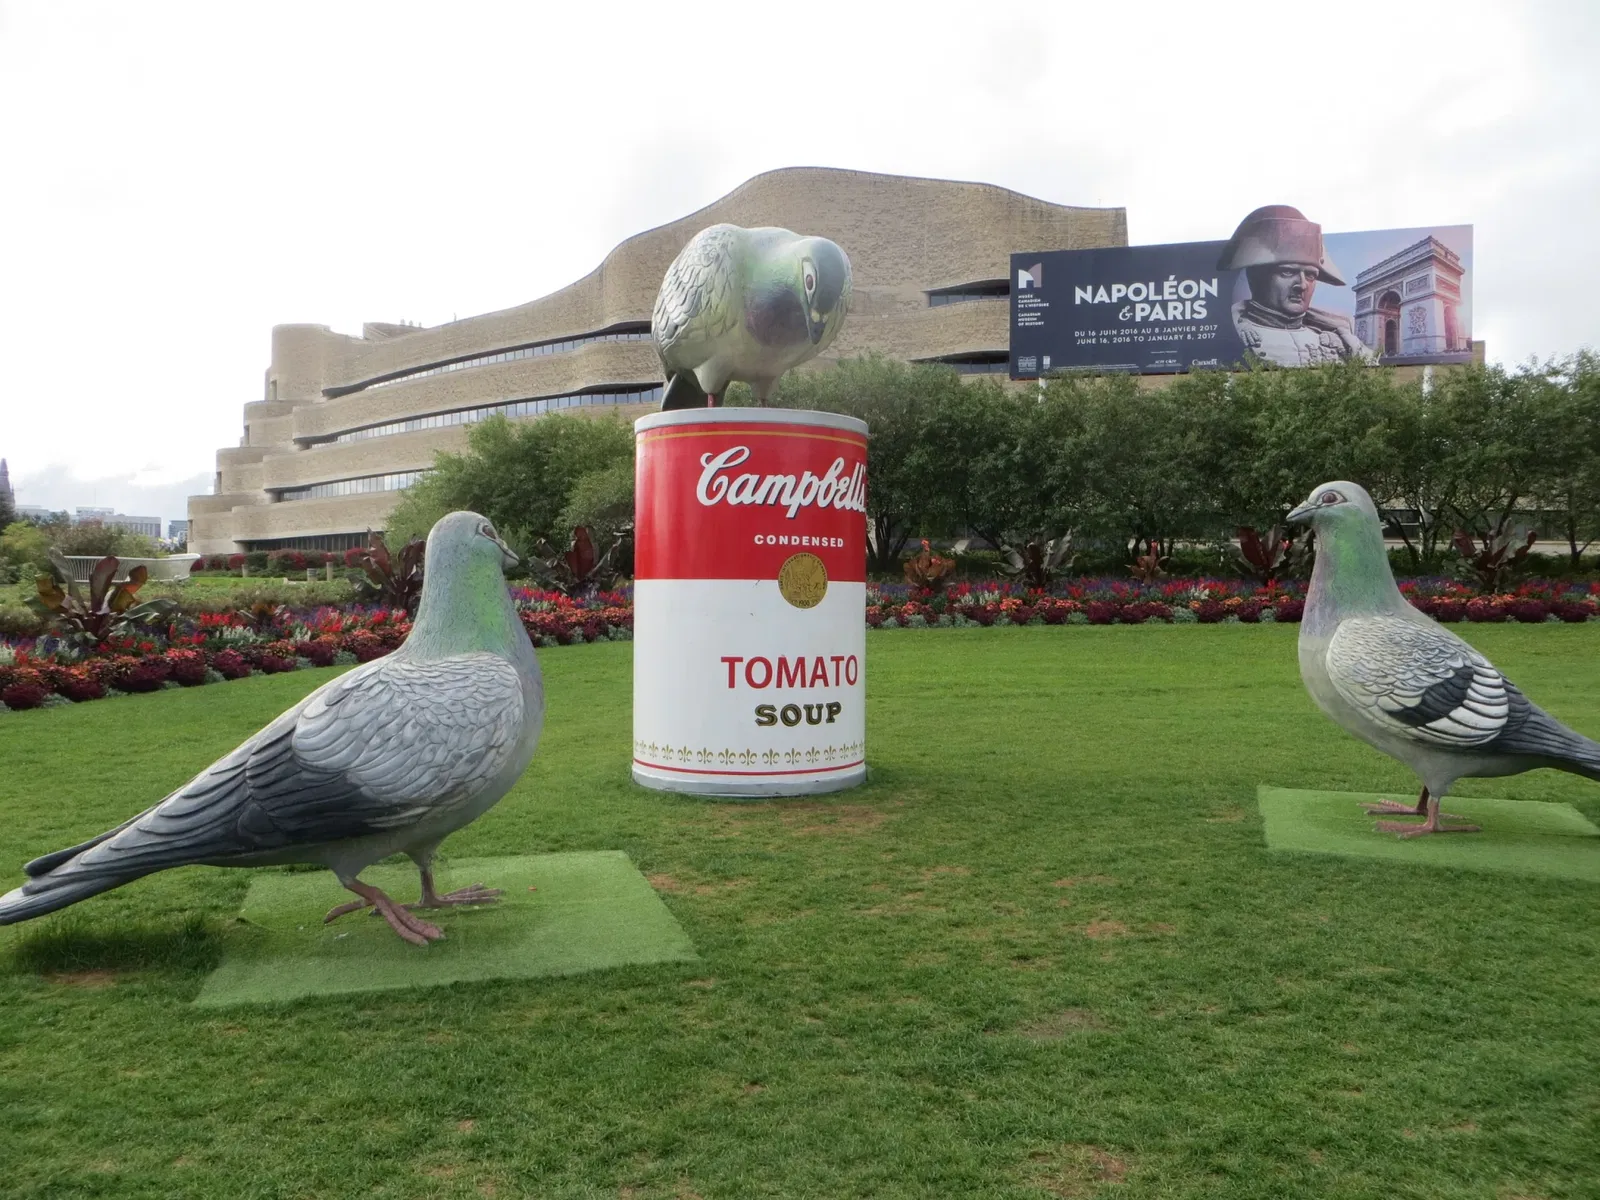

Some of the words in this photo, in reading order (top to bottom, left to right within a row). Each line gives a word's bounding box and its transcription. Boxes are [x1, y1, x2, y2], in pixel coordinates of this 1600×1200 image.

[1075, 275, 1218, 304] NAPOLÉON
[1119, 305, 1133, 321] &
[1135, 300, 1207, 322] PARIS
[1147, 334, 1184, 342] JANUARY
[1197, 332, 1216, 340] 2017
[1163, 325, 1196, 333] JANVIER
[754, 534, 844, 548] CONDENSED
[720, 654, 858, 689] TOMATO
[755, 701, 842, 727] SOUP
